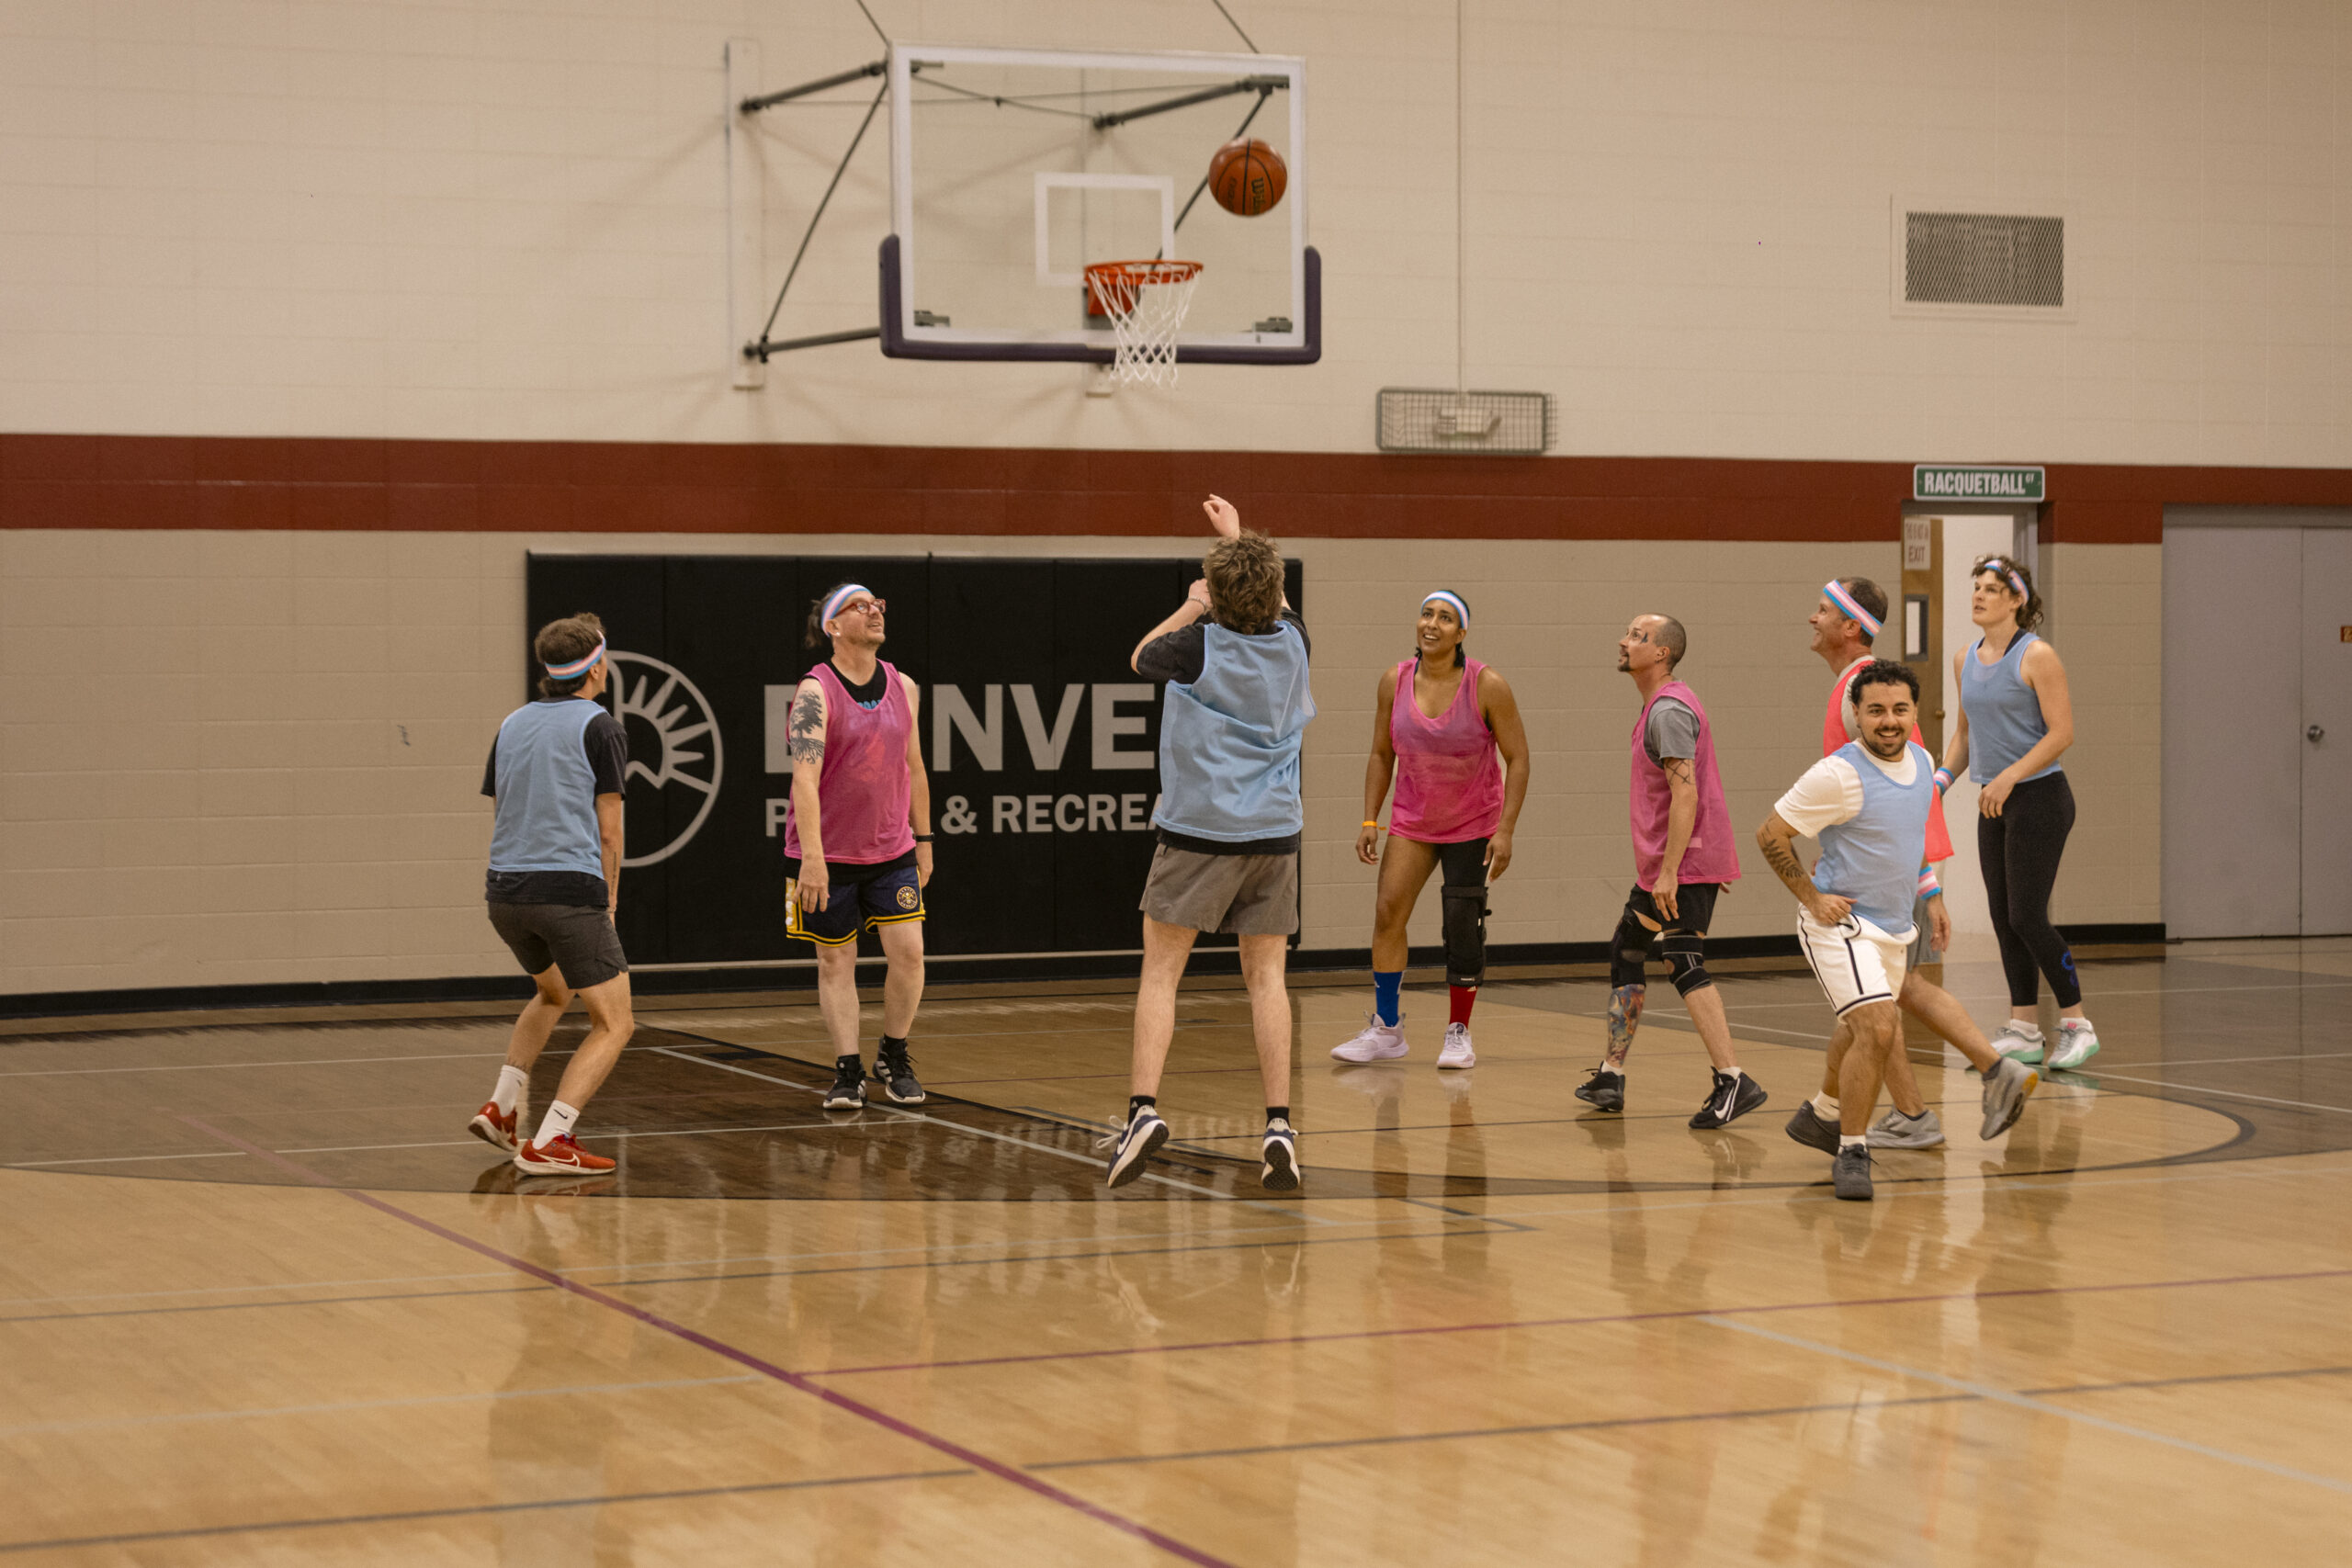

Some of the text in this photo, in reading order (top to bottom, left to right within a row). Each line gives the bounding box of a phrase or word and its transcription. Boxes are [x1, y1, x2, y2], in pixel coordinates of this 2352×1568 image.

[1924, 471, 2026, 496] RACQUETBALL
[1908, 546, 1926, 562] EXIT
[941, 795, 978, 835] &
